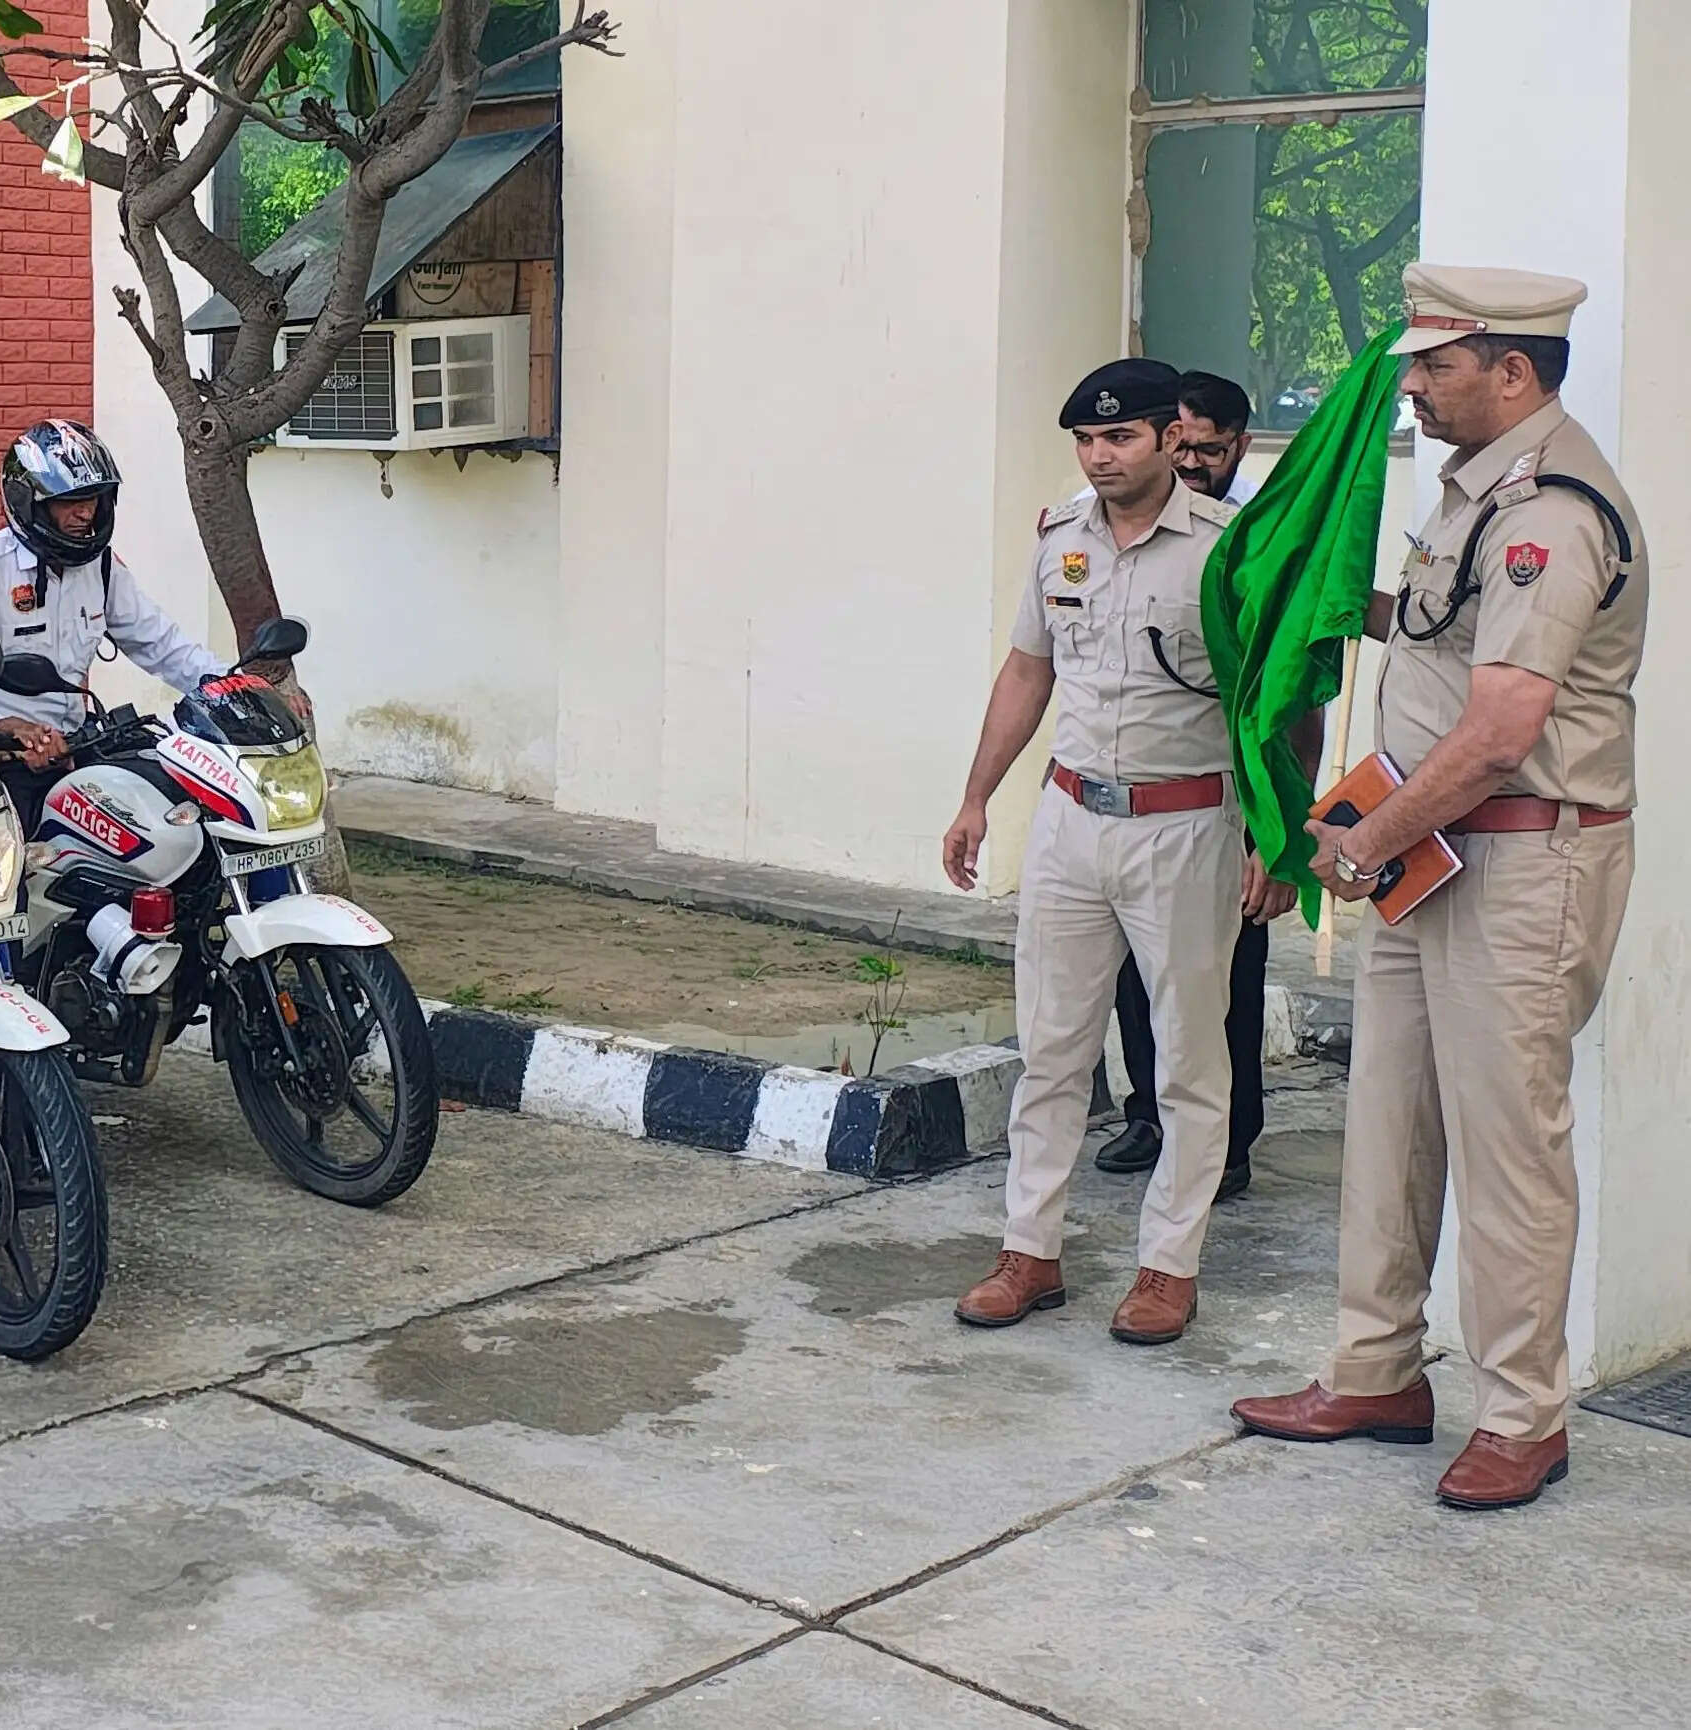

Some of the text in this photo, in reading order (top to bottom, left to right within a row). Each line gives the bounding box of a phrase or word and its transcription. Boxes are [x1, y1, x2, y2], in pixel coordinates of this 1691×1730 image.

[321, 374, 357, 390] OLTAS
[171, 736, 239, 794] KAITHAL
[62, 794, 121, 848] POLICE
